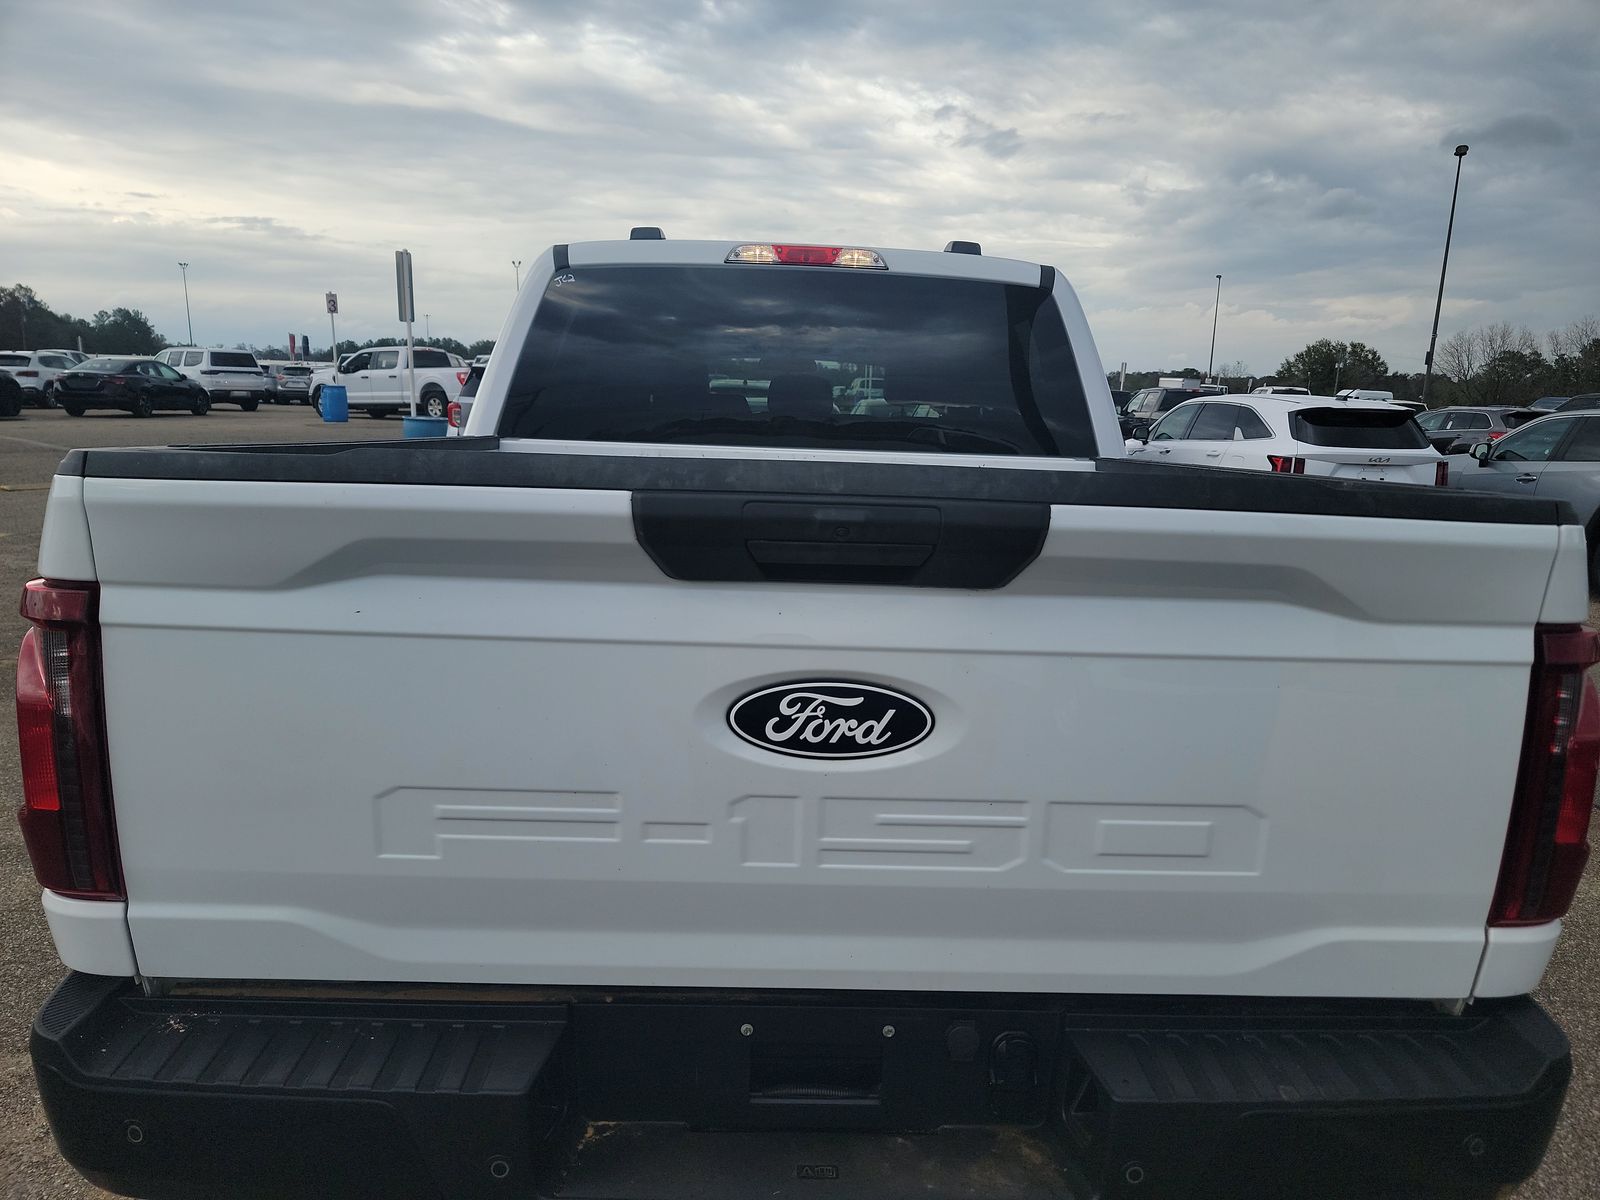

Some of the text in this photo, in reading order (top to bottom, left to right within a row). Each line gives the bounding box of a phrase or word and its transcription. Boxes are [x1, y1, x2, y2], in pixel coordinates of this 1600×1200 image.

[328, 299, 337, 313] 3
[764, 692, 896, 745] Ford
[373, 786, 1269, 876] F-150
